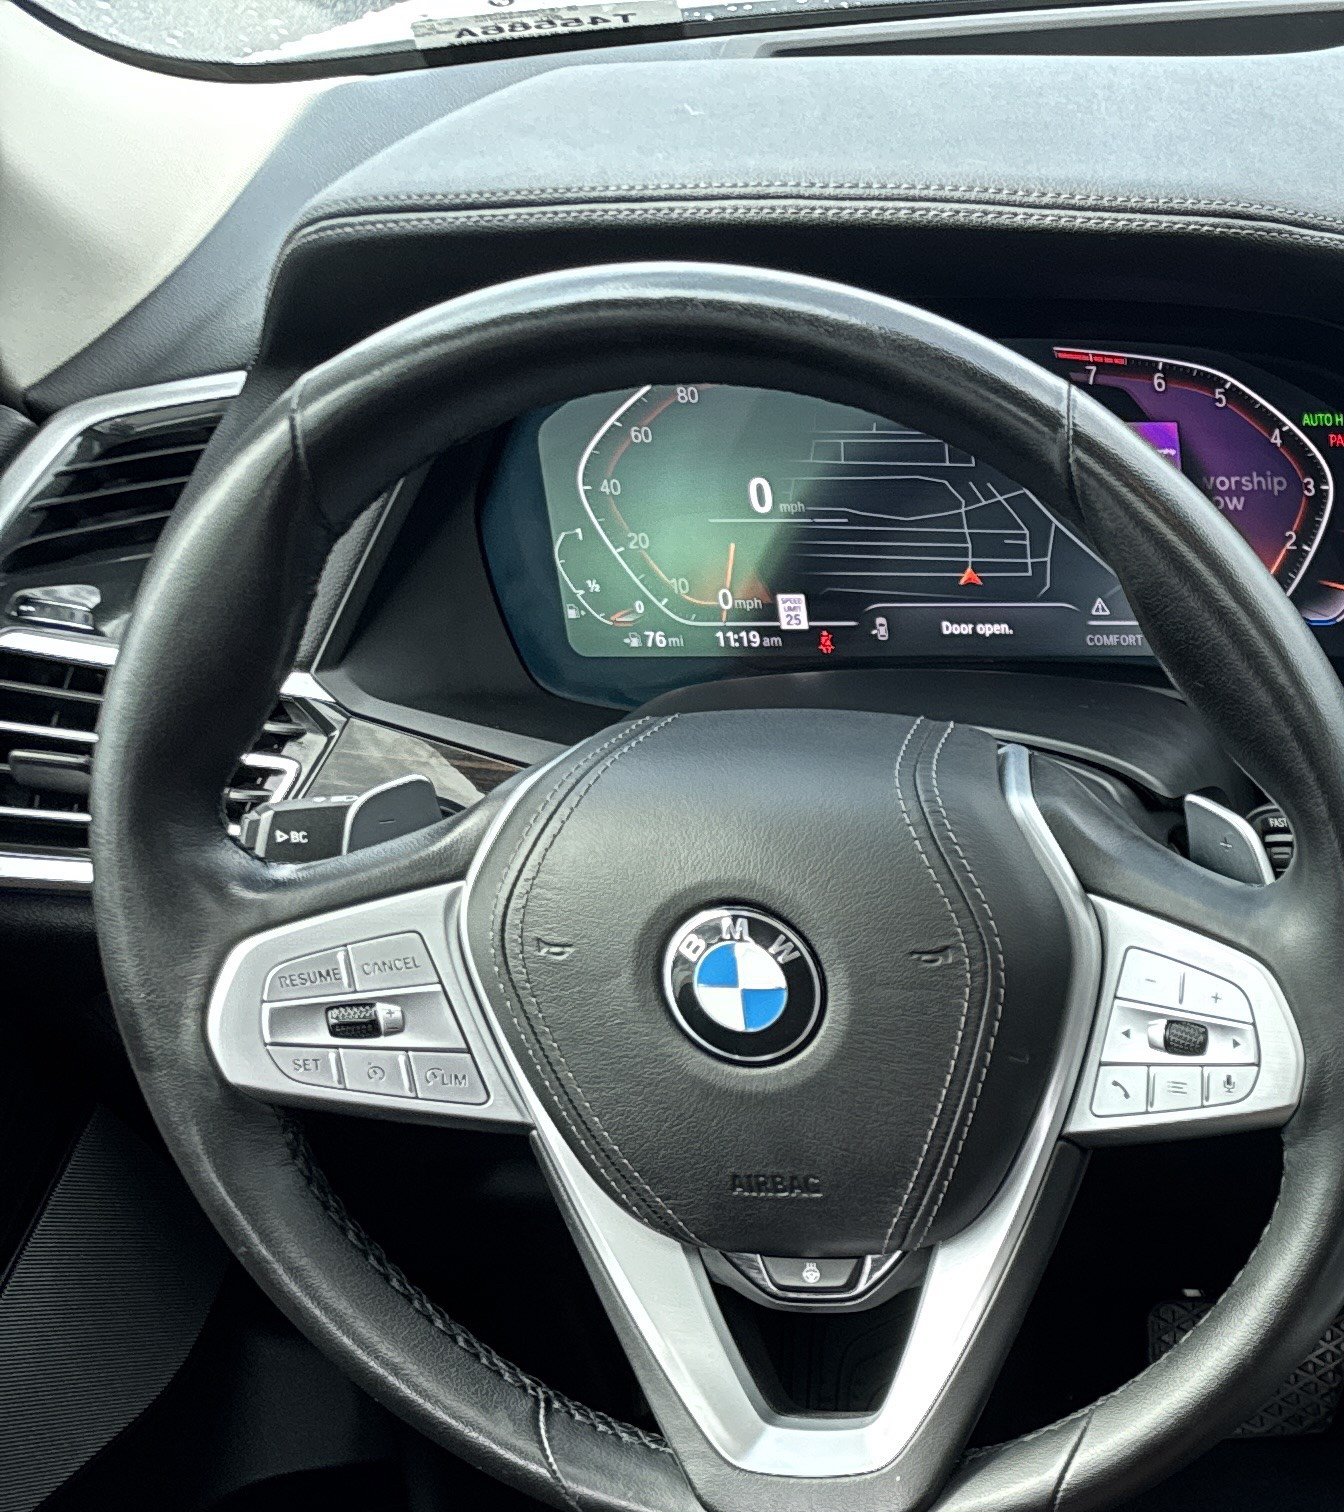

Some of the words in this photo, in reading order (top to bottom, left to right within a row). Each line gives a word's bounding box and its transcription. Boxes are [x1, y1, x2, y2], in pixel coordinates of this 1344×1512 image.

[1085, 366, 1098, 385] 7
[1153, 372, 1166, 392] 6
[676, 387, 699, 404] 80
[1214, 388, 1227, 408] 5
[1302, 413, 1333, 427] AUTO
[1334, 414, 1344, 426] H
[630, 427, 652, 443] 60
[1270, 428, 1282, 447] 4
[600, 479, 621, 496] 40
[1303, 477, 1315, 497] 3
[748, 476, 773, 513] 0
[780, 501, 806, 515] mph
[627, 533, 650, 549] 20
[1285, 531, 1298, 549] 2
[670, 578, 689, 594] 10
[634, 601, 645, 613] 0
[718, 589, 733, 609] 0
[734, 597, 762, 610] mph
[785, 613, 802, 626] 25
[941, 621, 974, 635] Door
[976, 622, 1014, 637] open.
[643, 631, 667, 647] 76
[668, 634, 684, 647] mi
[715, 631, 761, 647] 11:19
[762, 636, 782, 647] am
[1086, 634, 1143, 646] COMFORT
[1269, 817, 1288, 828] FAST
[290, 830, 308, 843] BC
[679, 917, 801, 964] BMW
[362, 956, 421, 976] CANCEL
[278, 967, 342, 989] RESUME
[292, 1059, 321, 1072] SET
[441, 1074, 468, 1087] LIM
